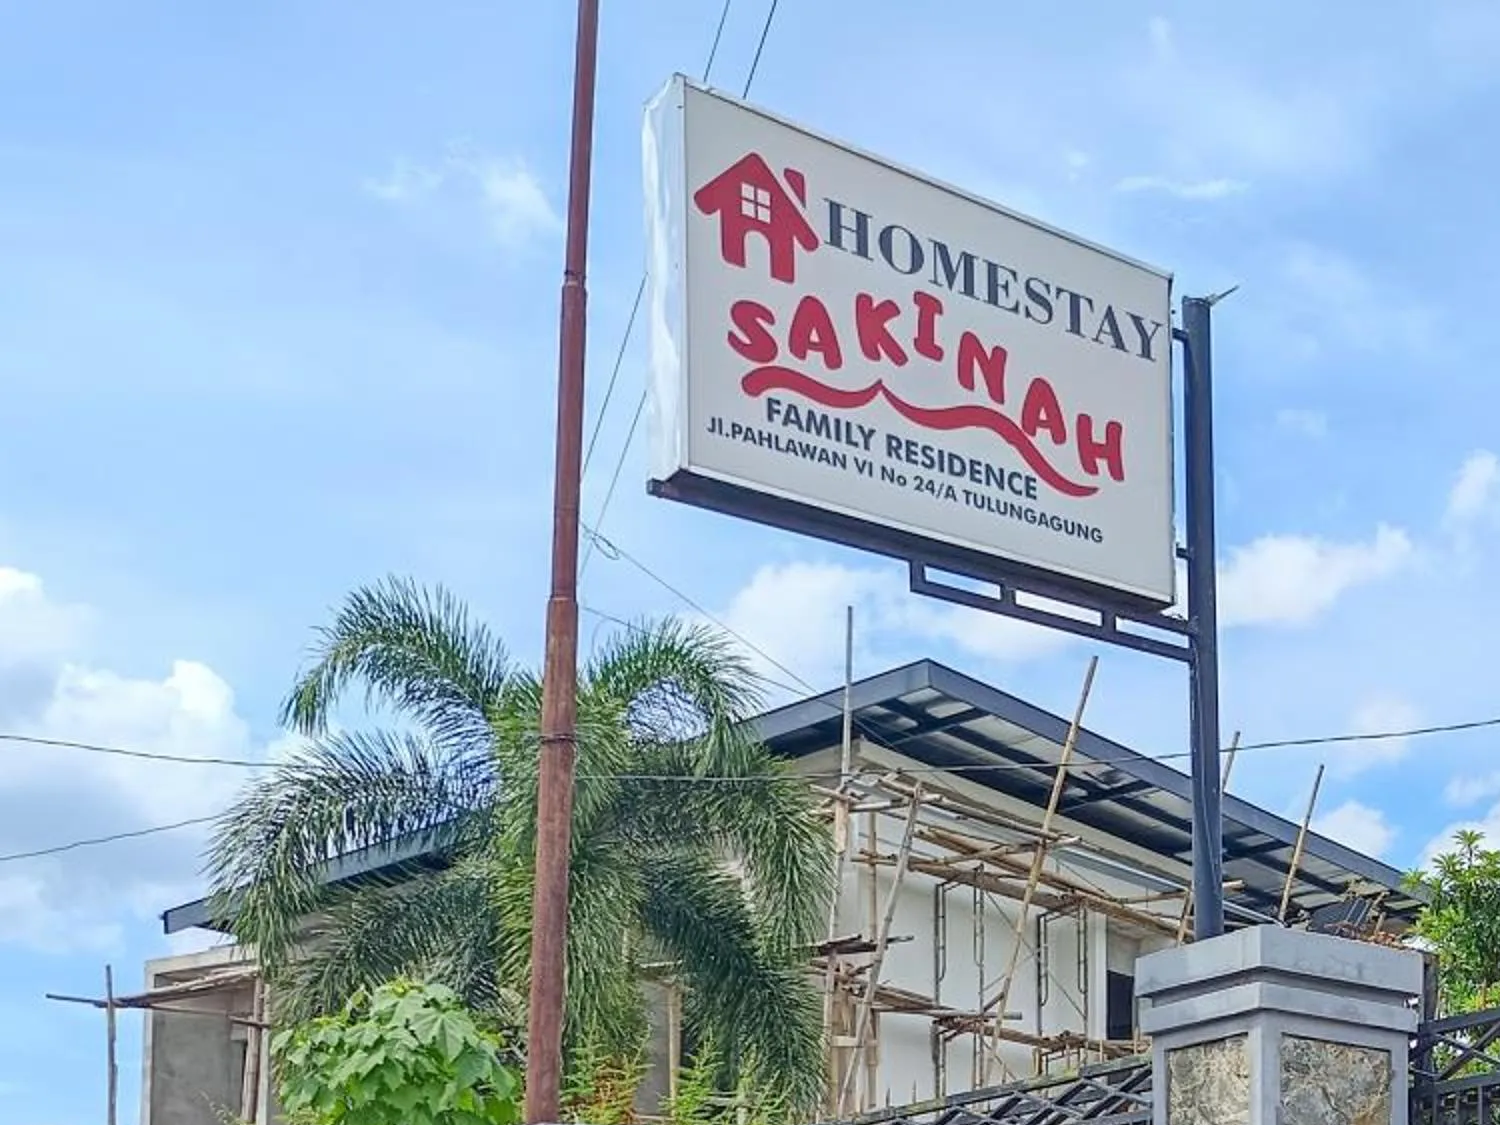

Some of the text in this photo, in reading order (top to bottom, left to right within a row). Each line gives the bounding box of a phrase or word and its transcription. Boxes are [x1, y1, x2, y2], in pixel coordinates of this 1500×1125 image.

[822, 197, 1164, 363] HOMESTAY
[727, 291, 1125, 482] SAKINAH
[765, 397, 1038, 501] FAMILY RESIDENCE
[853, 455, 874, 479] VI
[879, 464, 908, 488] No
[912, 474, 958, 503] 24/A
[961, 488, 1104, 544] TULUNGAGUNG
